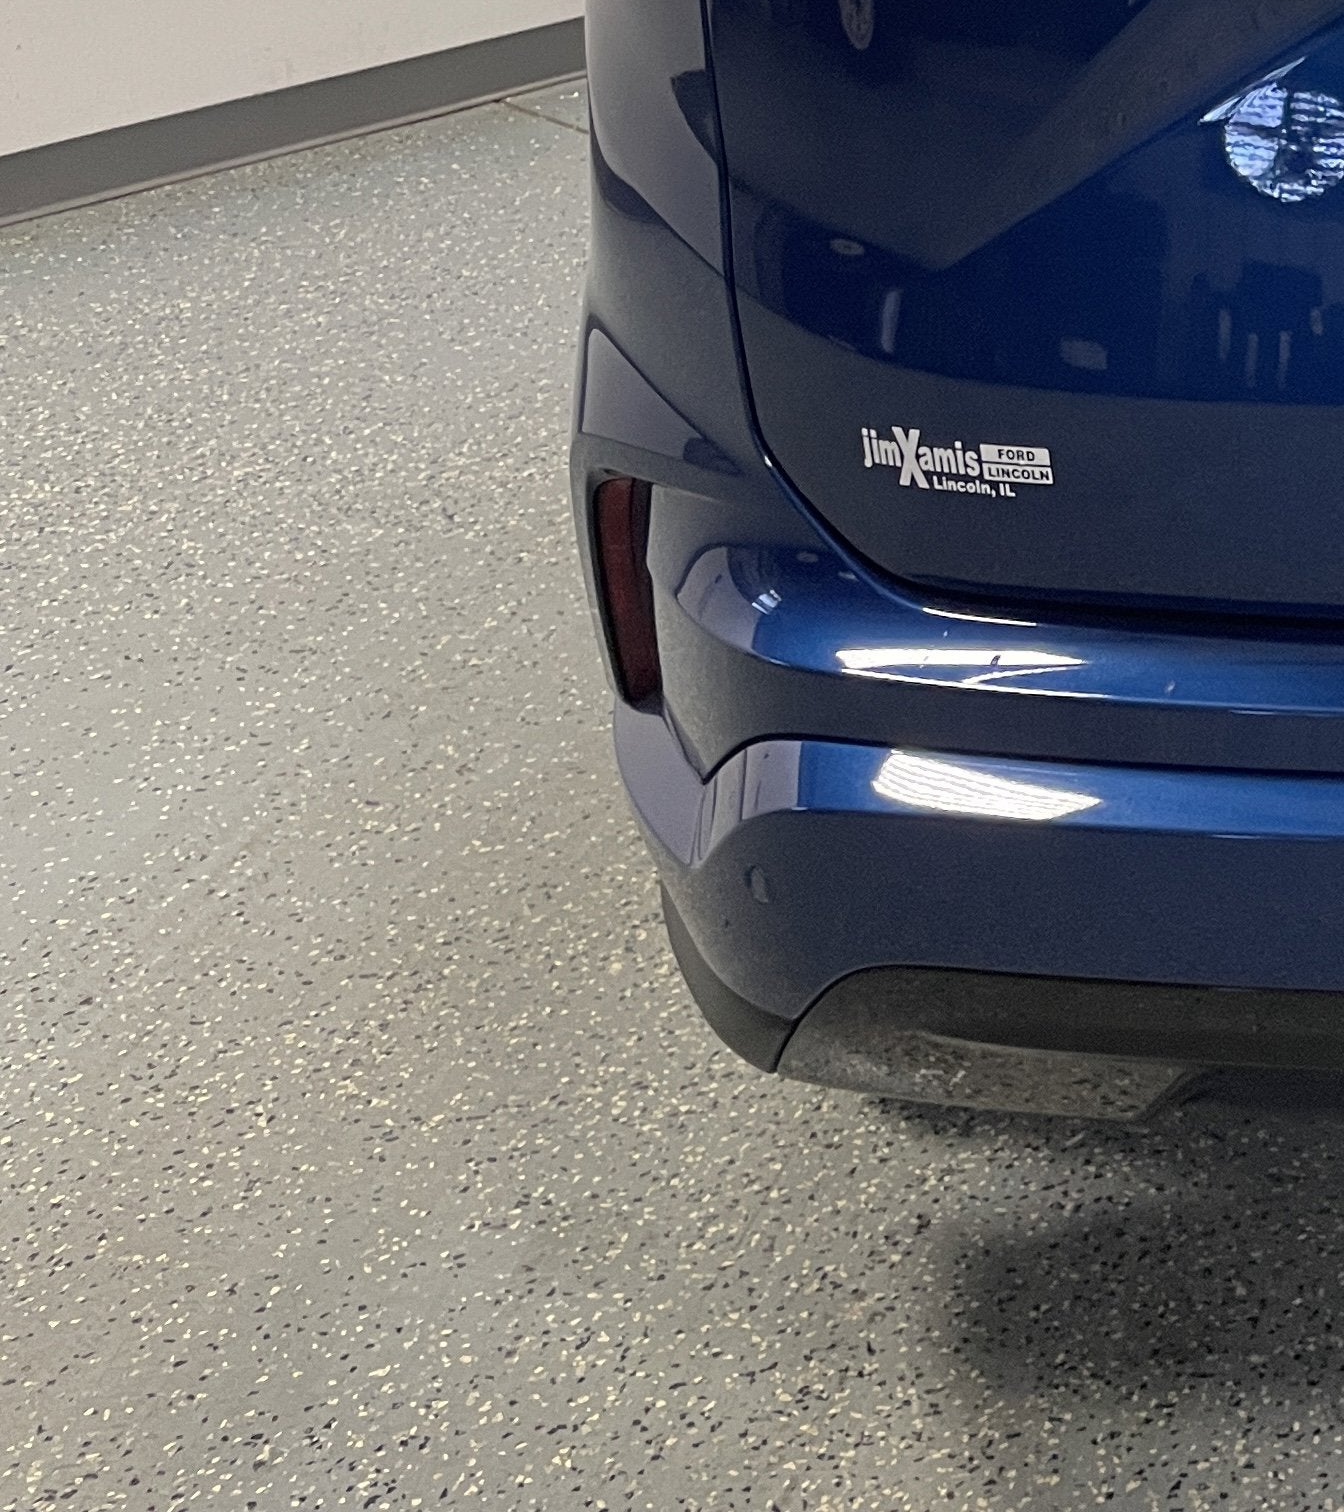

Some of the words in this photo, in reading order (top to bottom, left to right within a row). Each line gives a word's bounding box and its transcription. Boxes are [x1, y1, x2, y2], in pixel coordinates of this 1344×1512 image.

[997, 448, 1036, 462] FORD
[987, 466, 1050, 481] LINCOLN
[932, 475, 997, 498] Lincoln,
[999, 482, 1017, 498] IL
